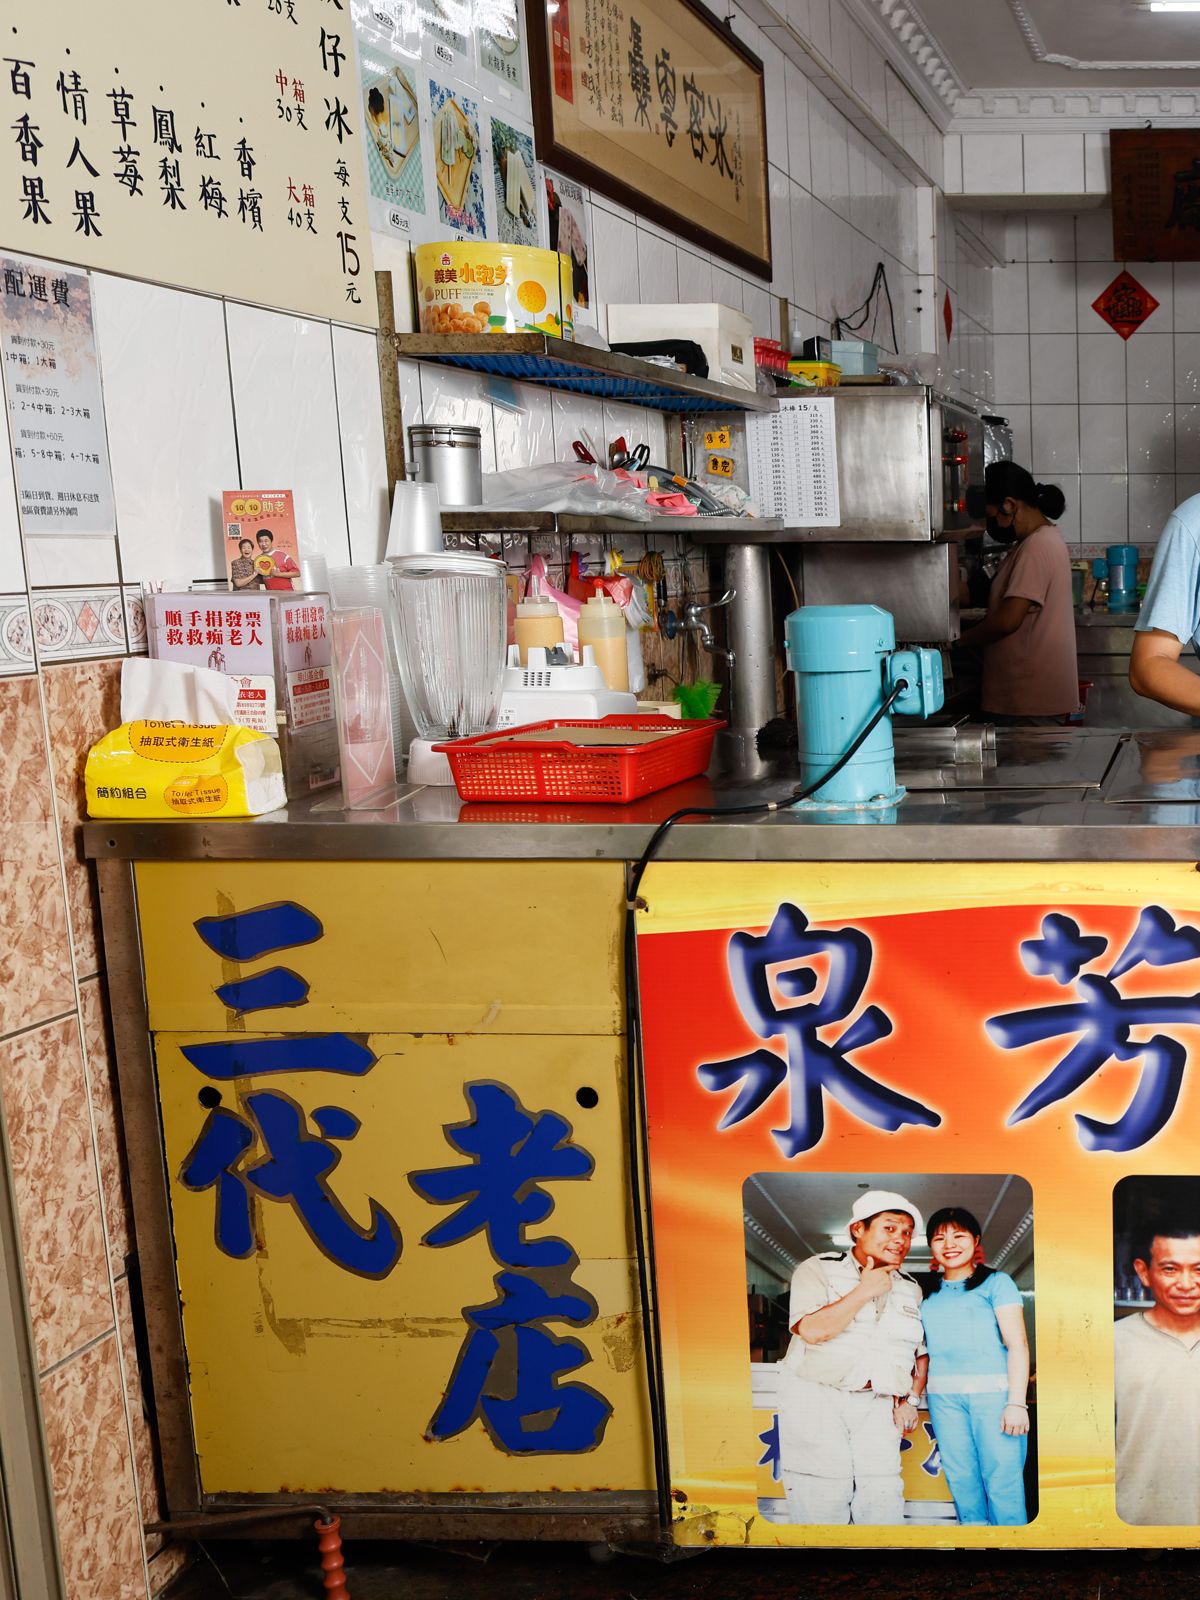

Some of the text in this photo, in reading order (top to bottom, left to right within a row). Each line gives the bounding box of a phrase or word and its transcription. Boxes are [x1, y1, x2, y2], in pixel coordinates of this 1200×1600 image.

[275, 68, 305, 104] 中箱
[319, 0, 353, 144] 仔冰
[276, 98, 308, 131] 30支
[2, 57, 52, 225] 百香果
[56, 70, 103, 237] 情人果
[105, 86, 144, 197] 草莓
[151, 105, 187, 210] 鳳梨
[194, 126, 229, 219] 紅梅
[286, 176, 315, 208] 大箱
[287, 207, 318, 234] 40支
[434, 268, 458, 284] 義美
[434, 288, 461, 301] PUFF
[165, 610, 262, 628] 順手捐發票
[285, 605, 325, 625] 順手捐發票
[139, 735, 215, 748] 抽取式衛生紙
[96, 787, 147, 799] 簡約組合
[171, 795, 222, 806] 抽取式衛生紙
[408, 1080, 615, 1456] 老店
